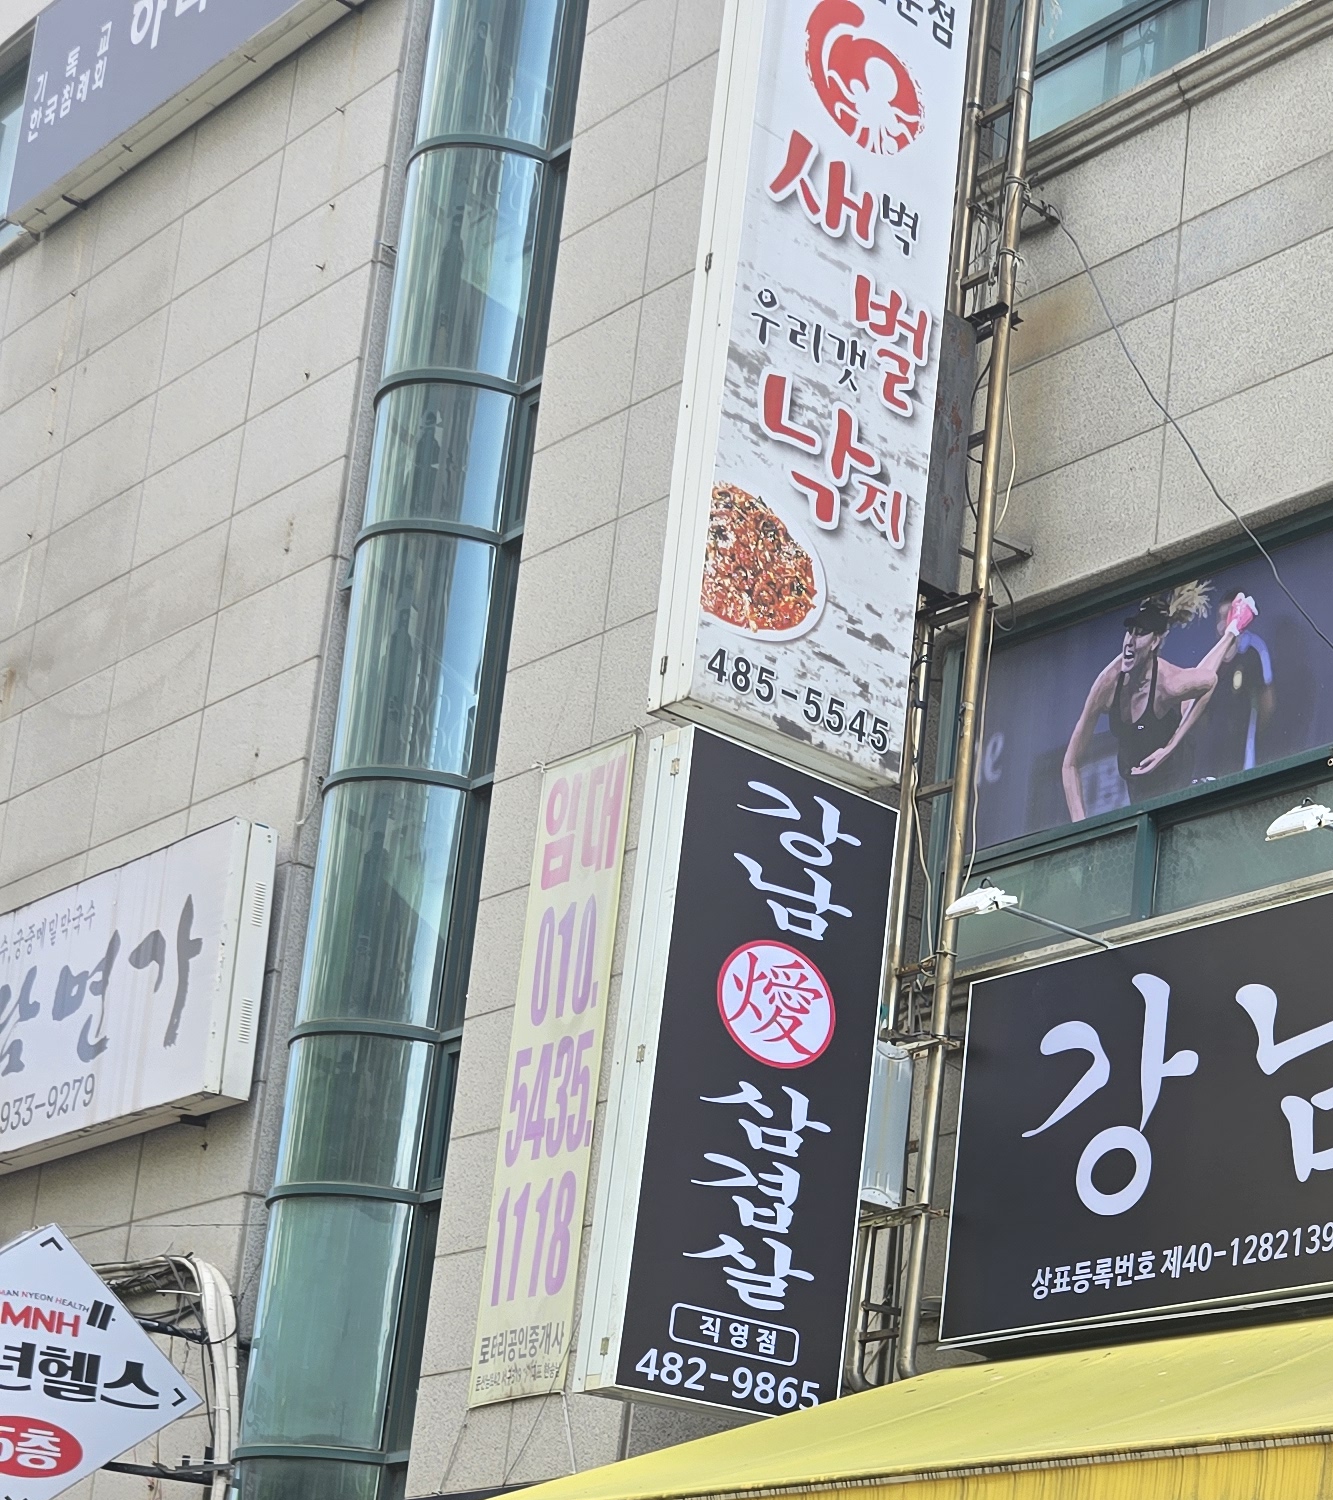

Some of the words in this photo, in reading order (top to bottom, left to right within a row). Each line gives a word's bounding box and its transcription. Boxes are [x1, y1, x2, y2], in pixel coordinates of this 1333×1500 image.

[28, 57, 107, 142] 한국침례회
[761, 372, 907, 550] 낙지
[706, 647, 891, 756] 485-5545
[540, 753, 626, 891] 임대
[734, 781, 862, 941] 강남
[491, 1170, 576, 1307] 1118
[683, 1080, 831, 1311] 삼겹살
[1, 1301, 80, 1337] MNH
[21, 1291, 54, 1302] NYEON
[55, 1297, 90, 1313] HEALTH
[1030, 1249, 1157, 1301] 상표등록번호
[635, 1348, 820, 1411] 482-9865
[700, 1315, 777, 1355] 직영점
